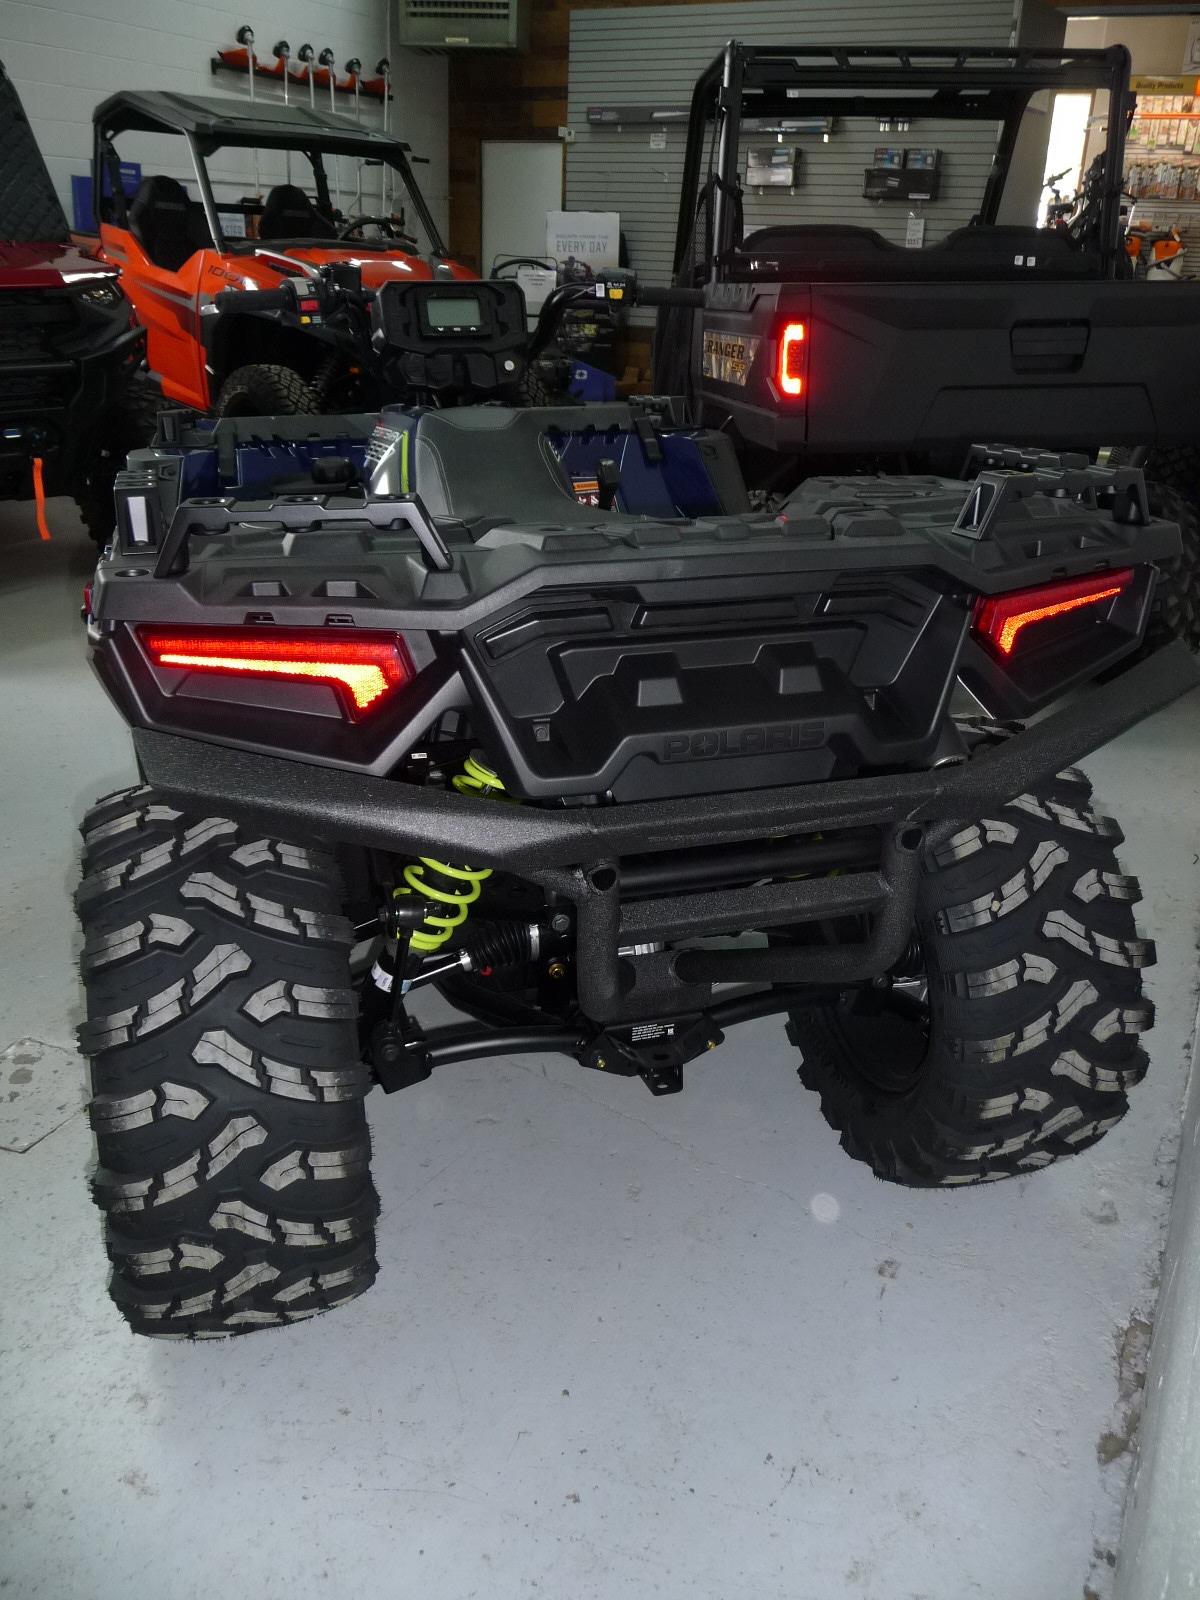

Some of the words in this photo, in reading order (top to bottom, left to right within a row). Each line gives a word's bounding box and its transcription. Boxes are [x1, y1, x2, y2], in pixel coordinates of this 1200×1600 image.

[556, 240, 585, 253] EVERY
[589, 240, 608, 254] DAY
[707, 339, 745, 361] RANGER
[663, 720, 826, 761] POLARIS
